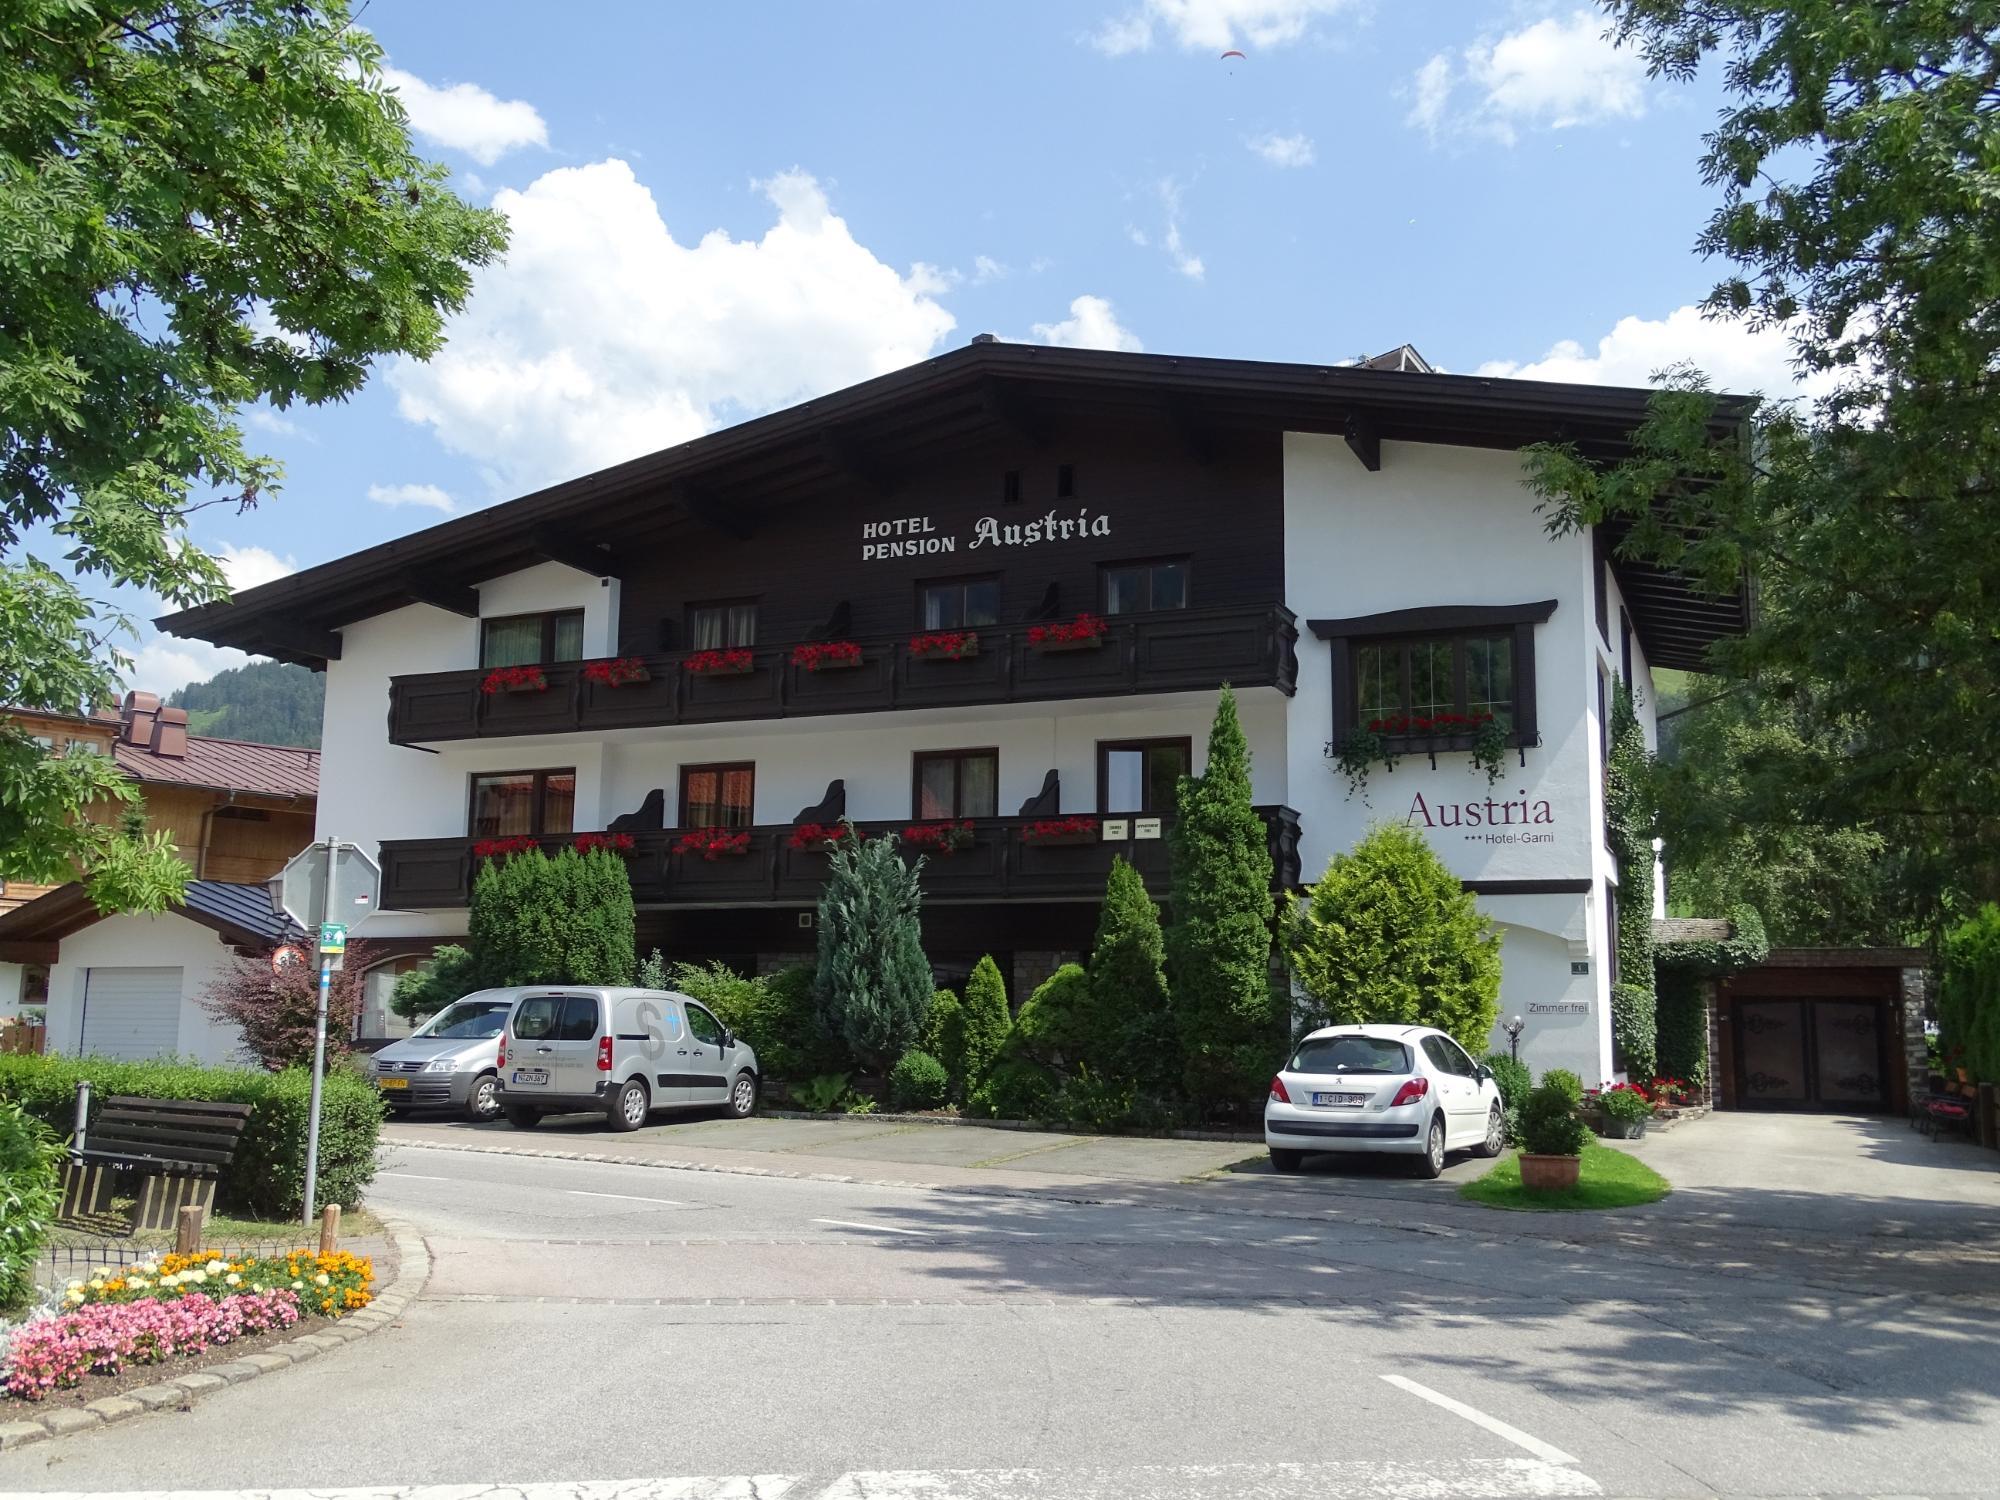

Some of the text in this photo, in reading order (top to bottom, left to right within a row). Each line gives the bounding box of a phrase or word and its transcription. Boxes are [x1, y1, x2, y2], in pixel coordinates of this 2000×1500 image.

[863, 517, 936, 539] HOTEL
[968, 508, 1111, 549] Austria
[862, 536, 956, 561] PENSION
[1401, 789, 1555, 828] Austria
[1485, 831, 1555, 845] Hotel-Garni
[1529, 1002, 1588, 1013] Zimmer frei
